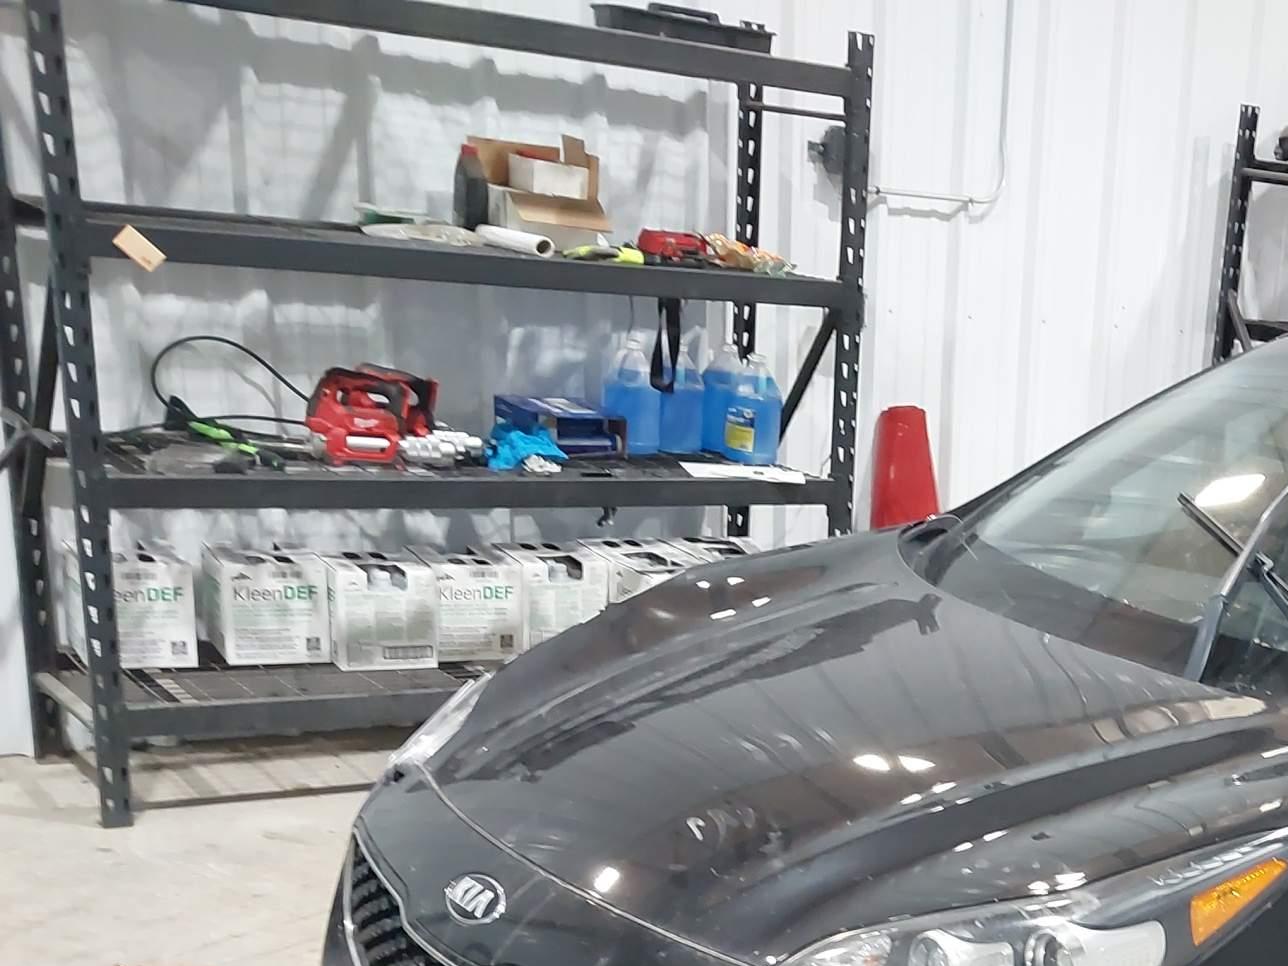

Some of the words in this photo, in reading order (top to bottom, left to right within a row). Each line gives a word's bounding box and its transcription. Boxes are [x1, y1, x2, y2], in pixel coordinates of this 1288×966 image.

[113, 586, 184, 602] eenDEF
[233, 584, 317, 602] KleenDEF
[439, 585, 514, 601] KleenDEF
[446, 875, 500, 920] KIA
